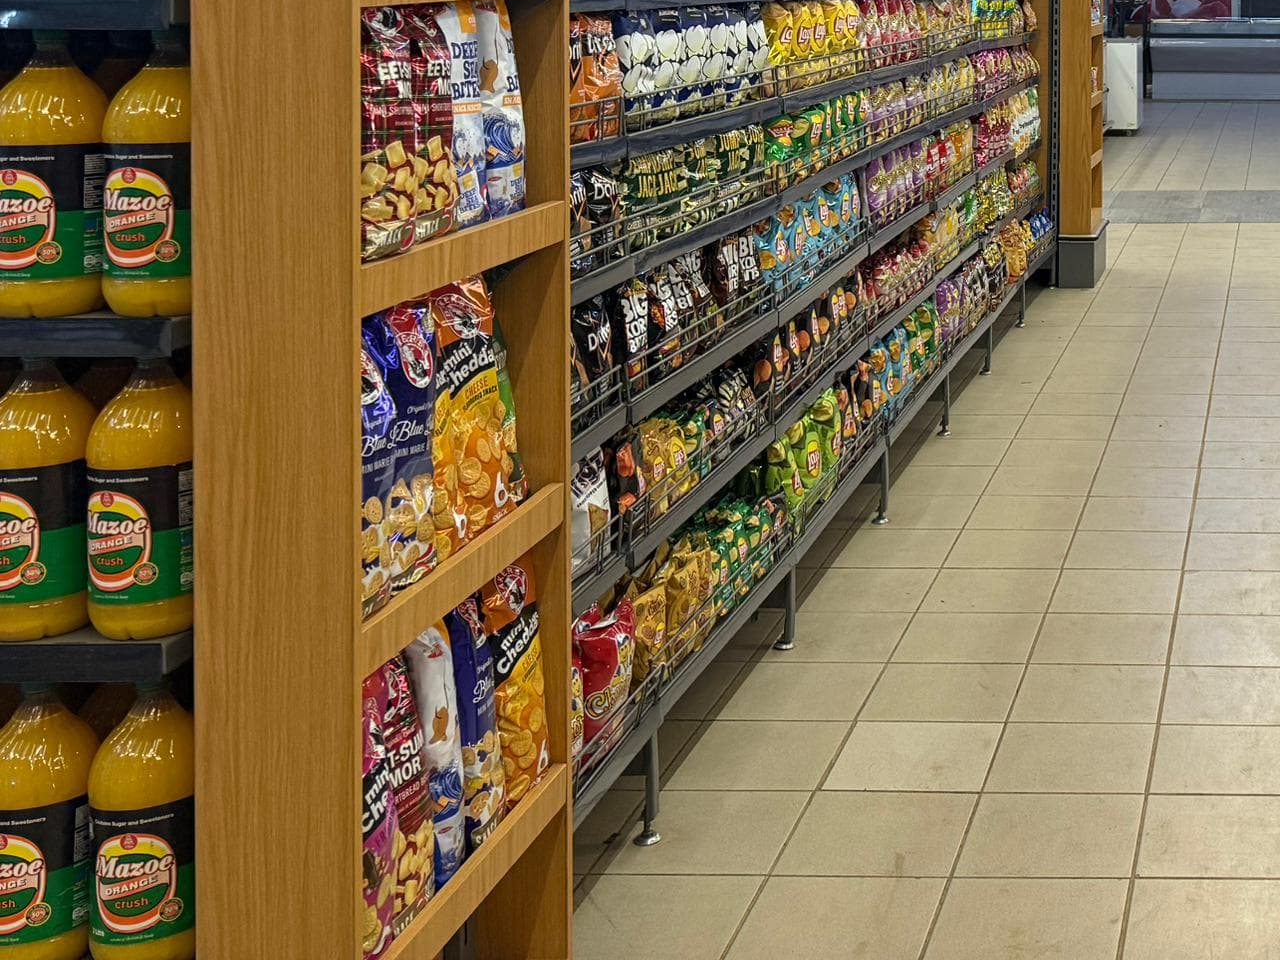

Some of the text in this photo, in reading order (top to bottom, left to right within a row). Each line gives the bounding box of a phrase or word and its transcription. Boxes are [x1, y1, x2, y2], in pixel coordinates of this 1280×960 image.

[103, 188, 174, 212] Mazoe
[109, 213, 156, 229] ORANGE
[115, 232, 146, 242] crush
[444, 342, 473, 372] mini
[465, 375, 489, 400] CHEESE
[395, 420, 425, 442] Blue
[361, 434, 388, 457] Blue
[88, 510, 148, 535] Mazoe
[97, 556, 124, 566] crush
[500, 617, 526, 652] mini
[97, 855, 175, 880] Mazoe
[105, 875, 160, 896] ORANGE
[114, 898, 149, 910] crush
